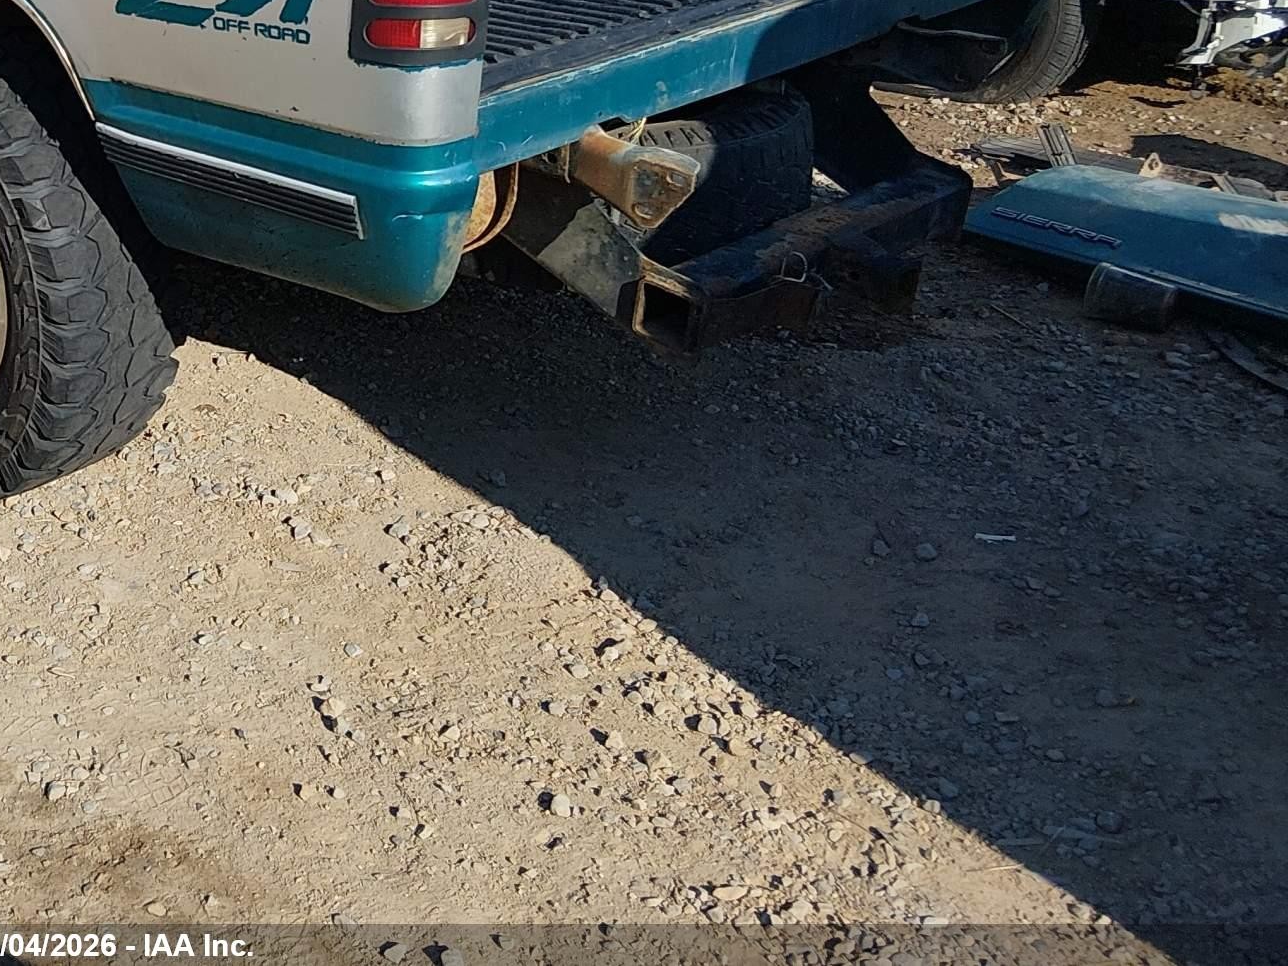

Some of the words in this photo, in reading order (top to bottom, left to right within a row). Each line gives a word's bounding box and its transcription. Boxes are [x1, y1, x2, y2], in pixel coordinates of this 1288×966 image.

[212, 16, 251, 33] OFF
[254, 22, 311, 44] ROAD
[990, 206, 1124, 250] SIERRA
